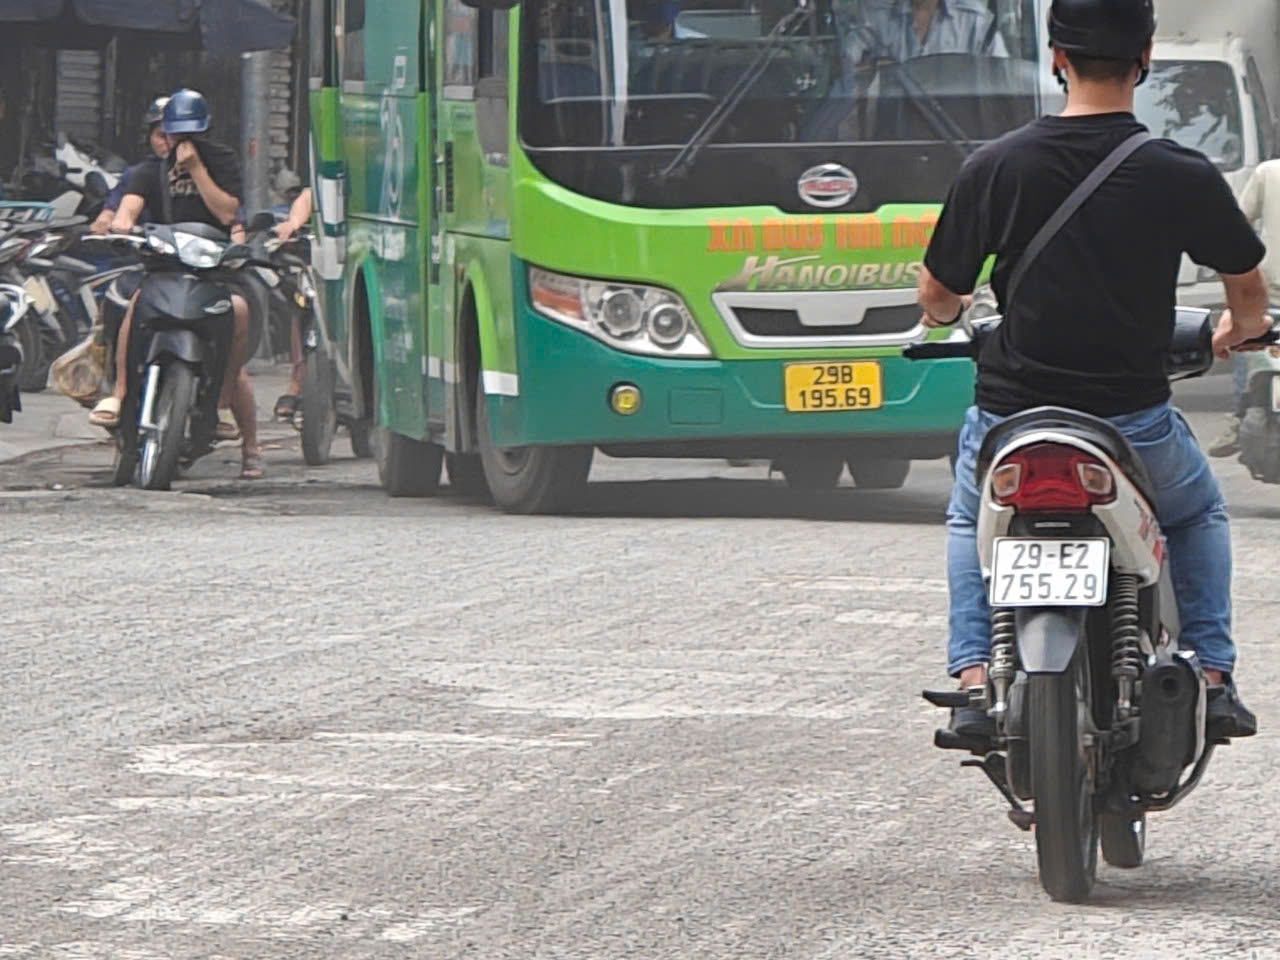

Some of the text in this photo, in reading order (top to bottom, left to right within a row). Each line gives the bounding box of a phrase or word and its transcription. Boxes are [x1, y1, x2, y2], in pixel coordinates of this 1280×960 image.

[812, 365, 853, 385] 29B
[799, 387, 871, 409] 195.69
[1000, 573, 1097, 601] 755.29
